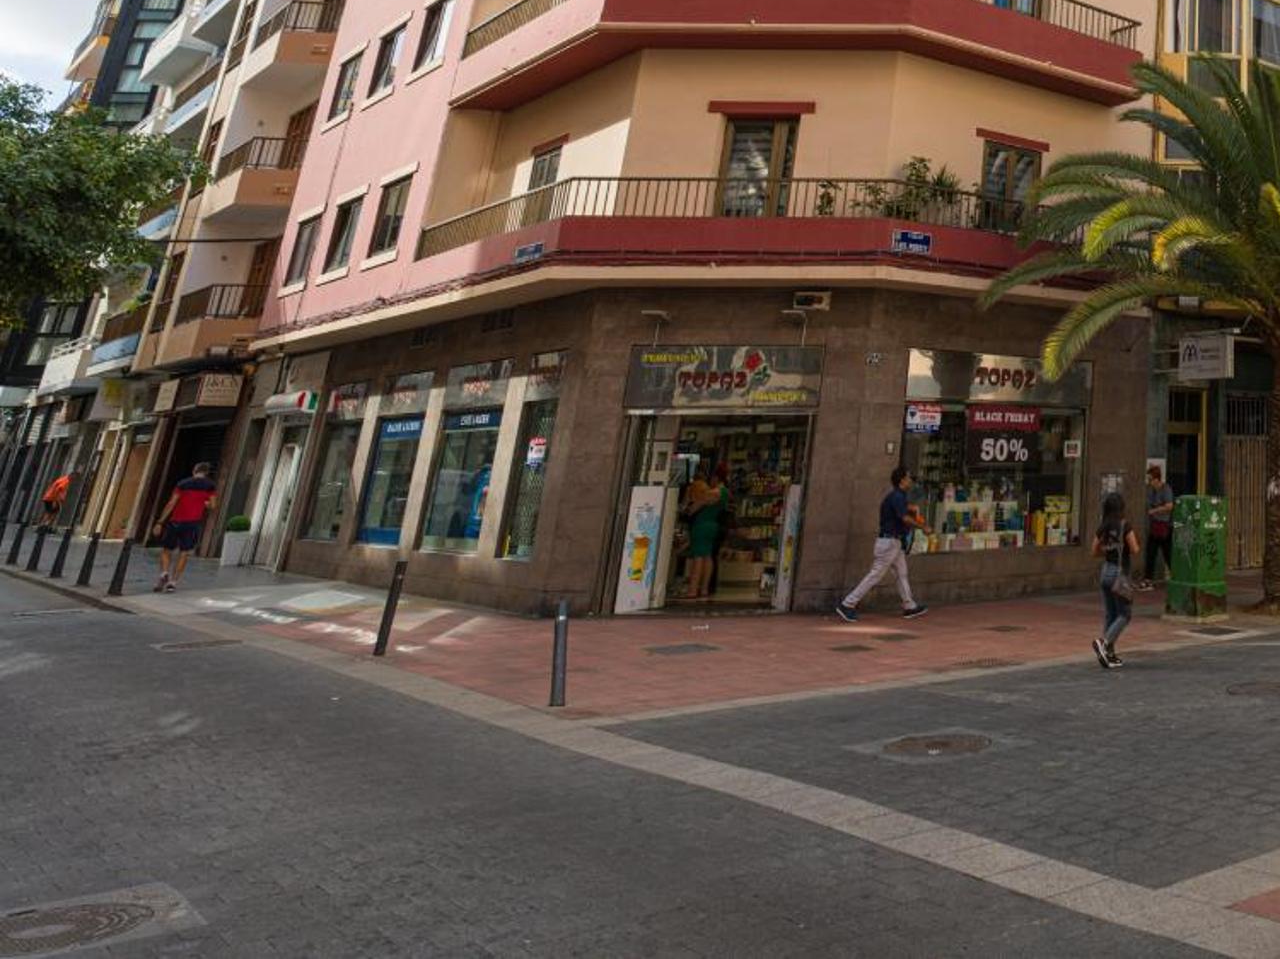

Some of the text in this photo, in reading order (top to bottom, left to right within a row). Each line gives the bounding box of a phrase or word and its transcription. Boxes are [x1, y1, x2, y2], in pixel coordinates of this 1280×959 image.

[678, 371, 748, 390] TOPAZ
[975, 366, 1037, 390] TOPAZ
[975, 411, 1036, 423] BLACK FRIDAY
[980, 437, 1029, 462] 50%
